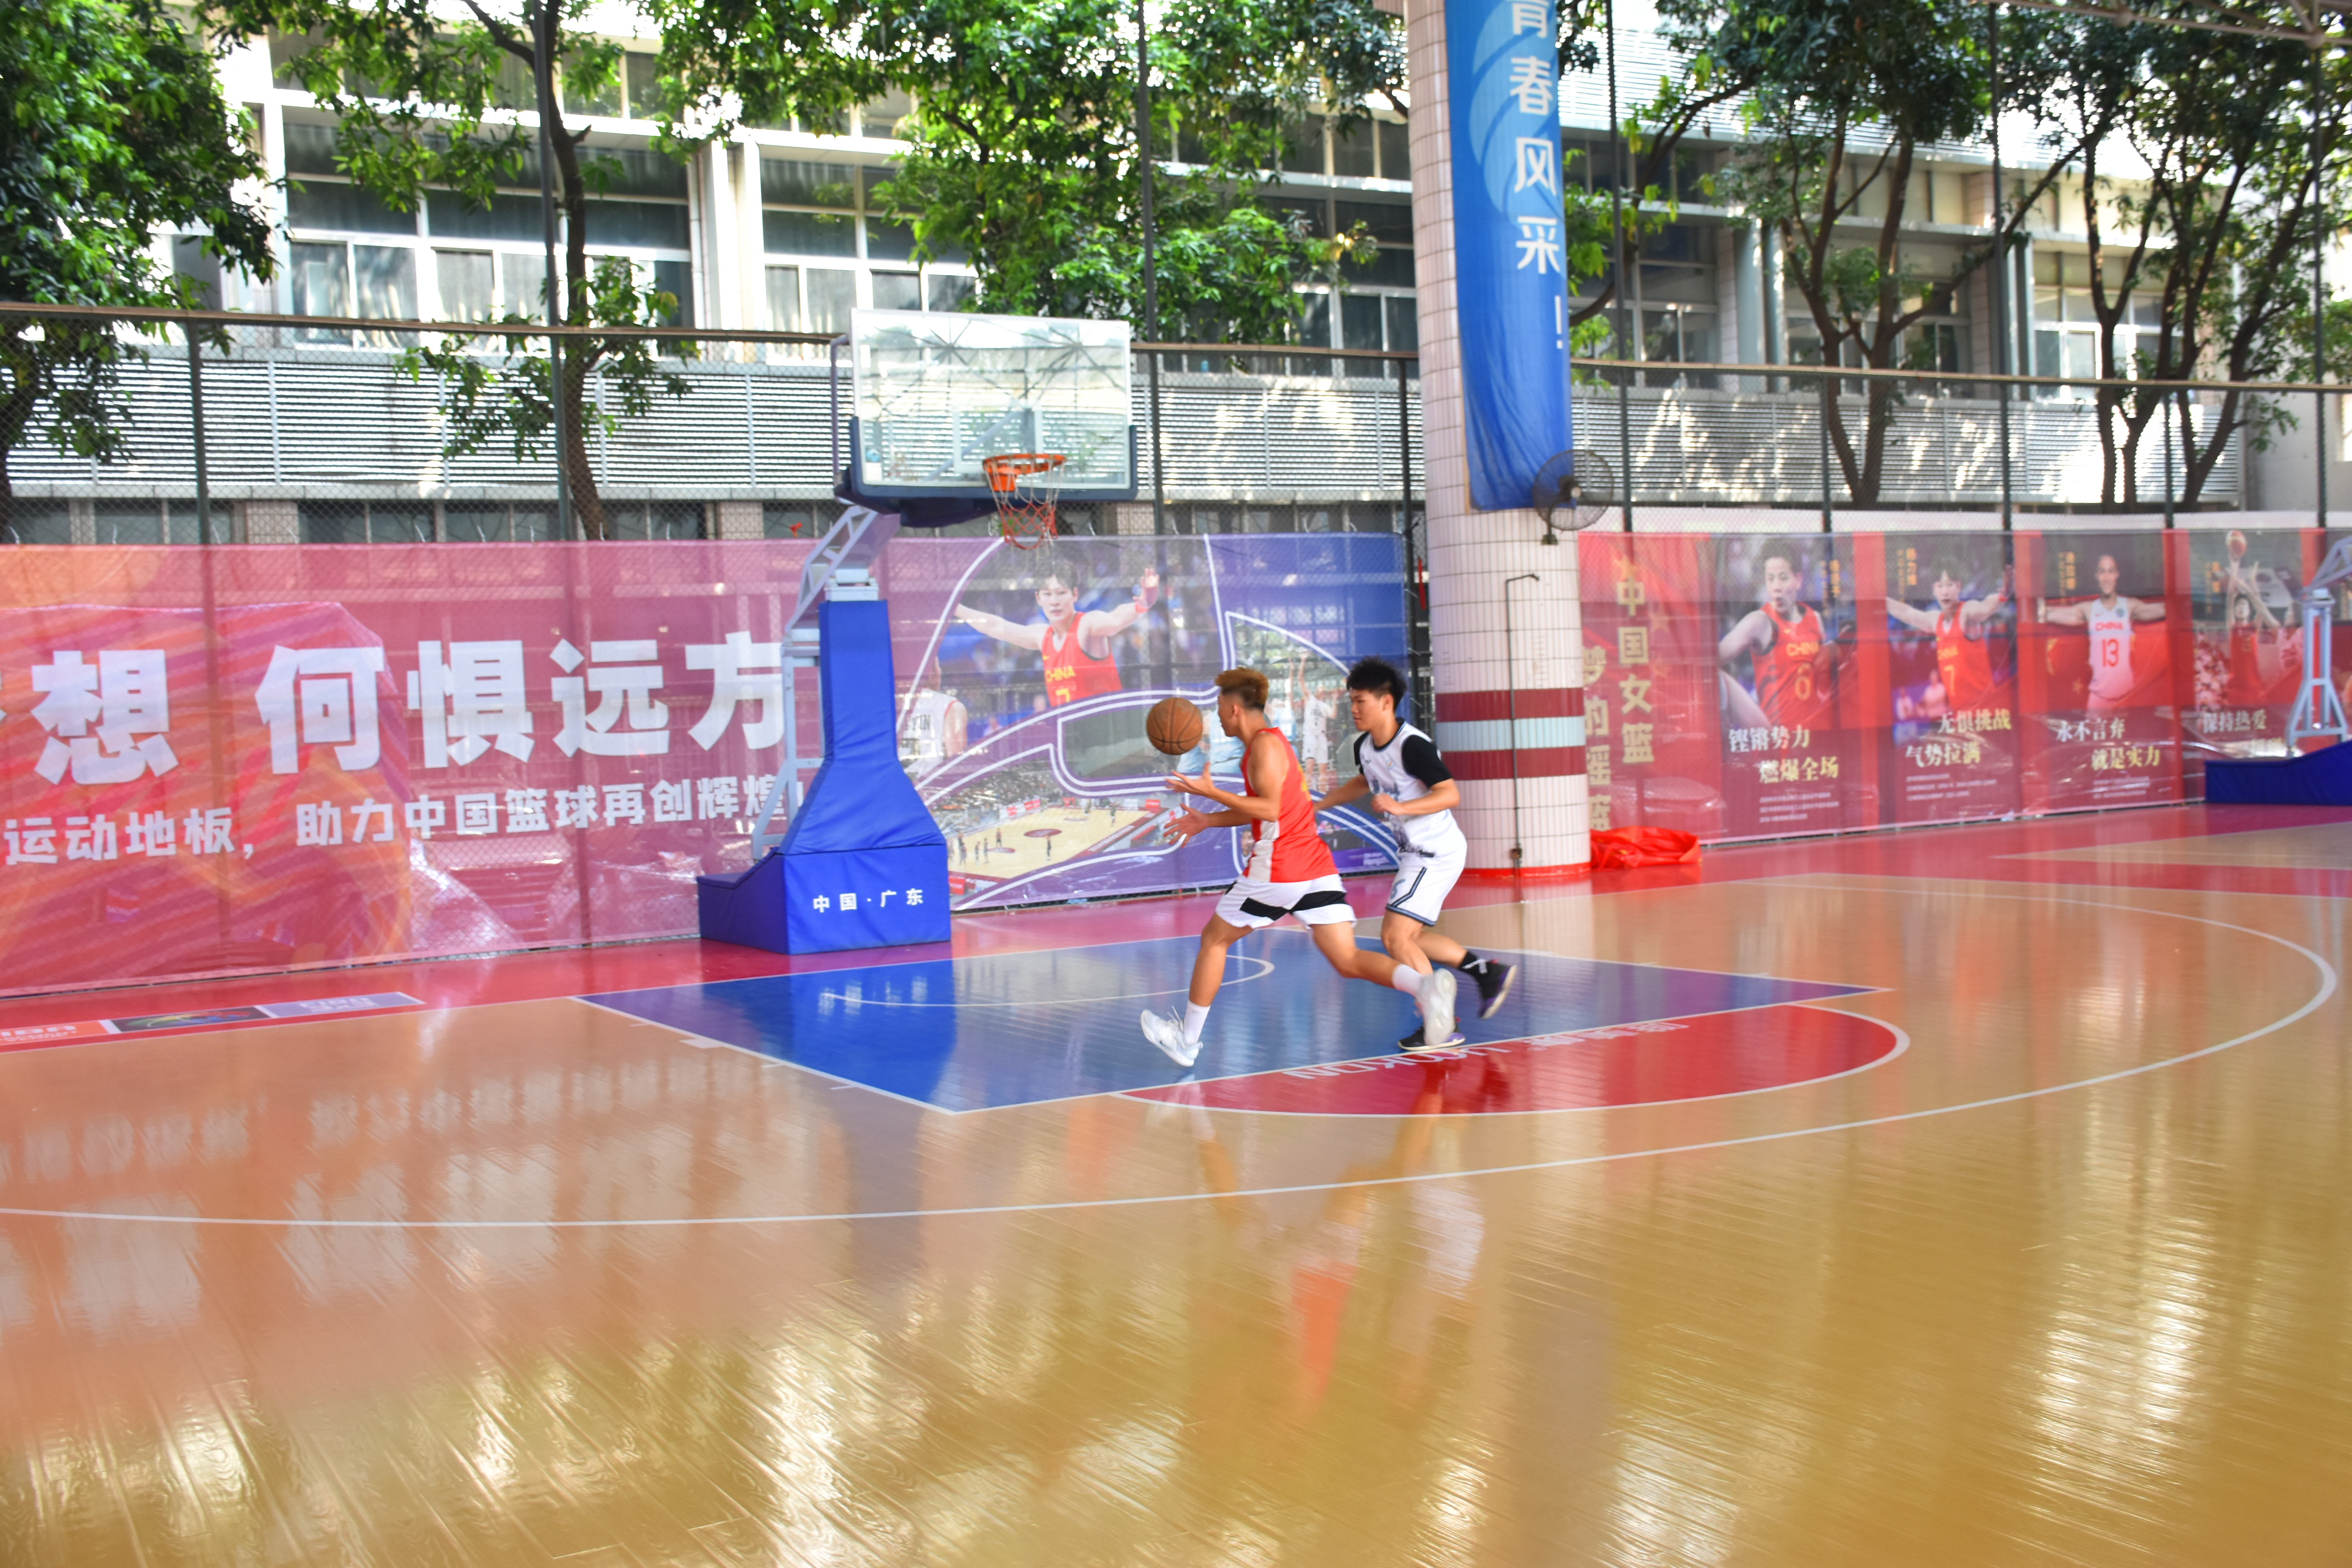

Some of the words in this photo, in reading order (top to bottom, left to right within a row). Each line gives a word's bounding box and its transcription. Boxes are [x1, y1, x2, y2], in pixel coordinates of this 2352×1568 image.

[2102, 638, 2120, 668] 13
[1617, 576, 1655, 764] 中国女篮
[0, 649, 179, 785] 想
[254, 630, 784, 775] 何惧远方
[1937, 708, 2012, 733] 无惧挑战
[2056, 717, 2125, 742] 永不言弃
[2091, 745, 2161, 771] 就是实力
